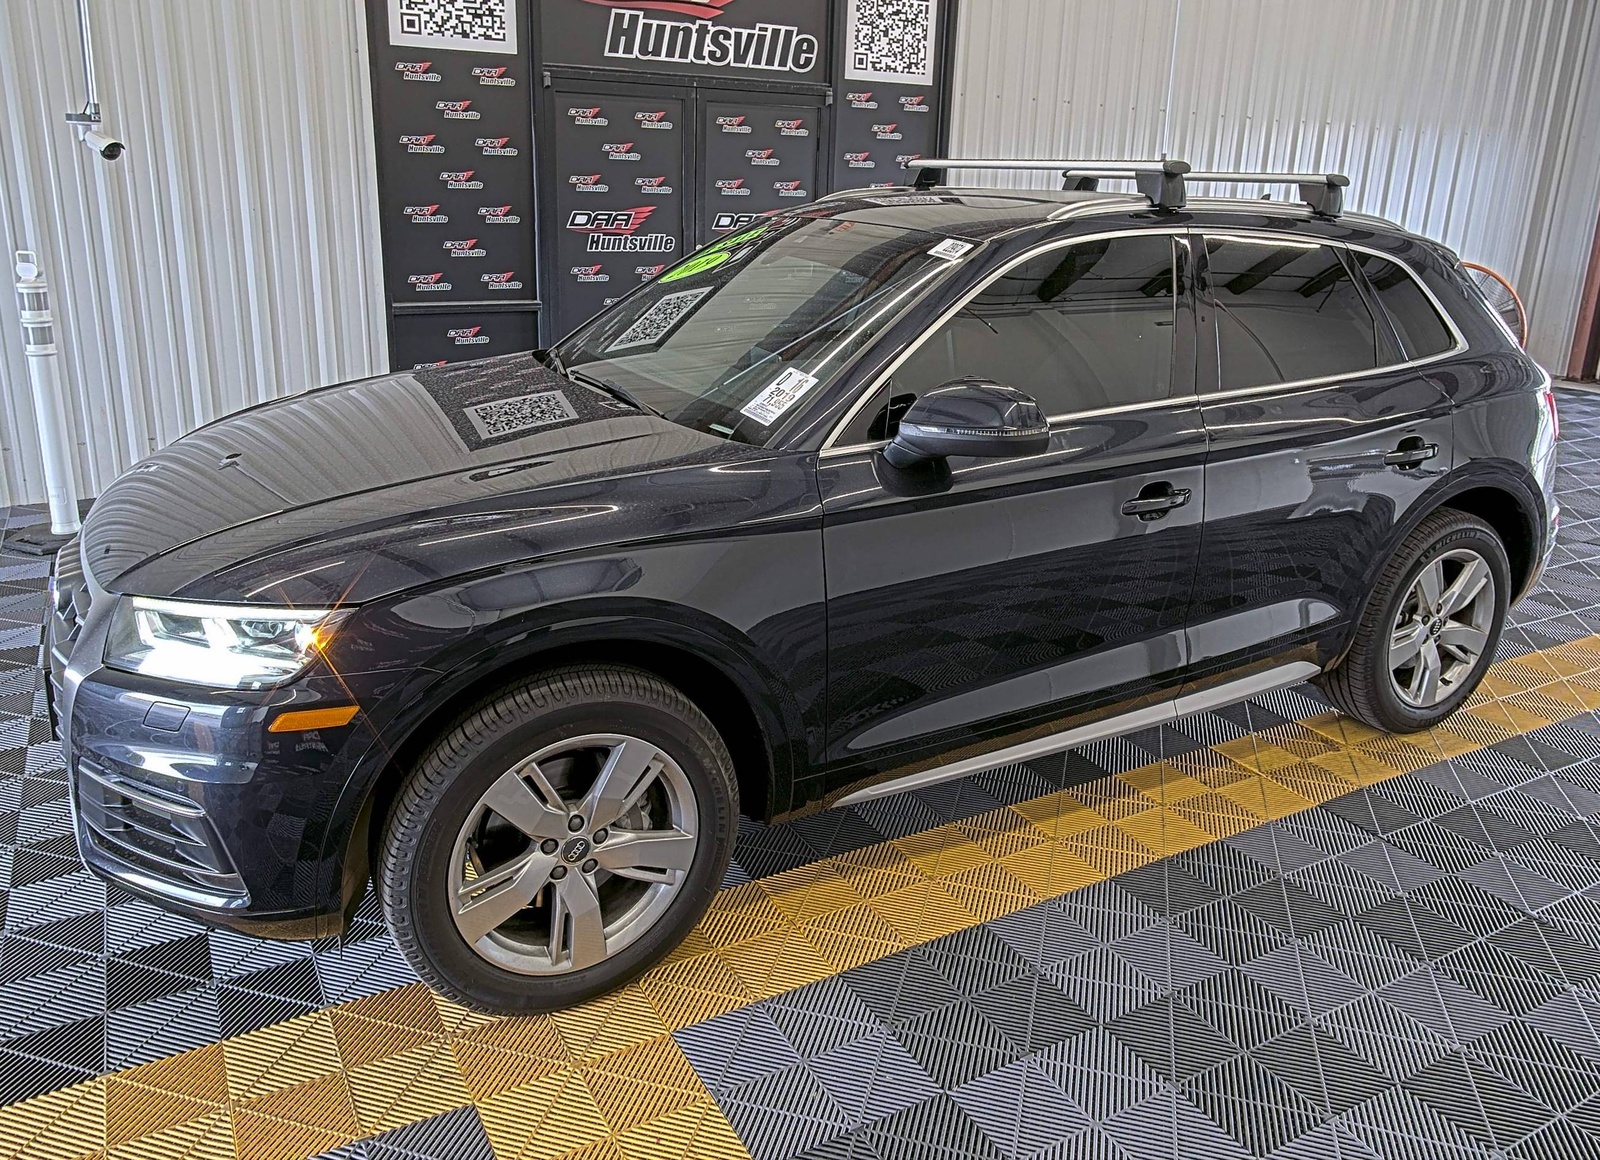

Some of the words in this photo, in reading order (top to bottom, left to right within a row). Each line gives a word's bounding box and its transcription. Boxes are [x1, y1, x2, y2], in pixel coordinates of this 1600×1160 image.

[604, 8, 818, 73] Huntsville
[395, 62, 423, 72] DAA
[403, 72, 442, 82] Huntsville
[472, 68, 498, 77] DAA
[480, 77, 515, 87] Huntsville
[436, 102, 463, 111] DAA
[444, 110, 480, 120] Huntsville
[568, 108, 594, 117] DAA
[634, 112, 658, 121] DAA
[575, 117, 608, 127] Huntsville
[641, 121, 673, 130] Huntsville
[399, 135, 427, 145] DAA
[475, 138, 502, 147] DAA
[408, 144, 445, 154] Huntsville
[483, 147, 518, 156] Huntsville
[602, 143, 627, 152] DAA
[609, 152, 641, 161] Huntsville
[439, 172, 466, 181] DAA
[569, 175, 594, 184] DAA
[447, 181, 484, 190] Huntsville
[635, 177, 659, 186] DAA
[576, 184, 609, 192] Huntsville
[641, 186, 673, 194] Huntsville
[404, 206, 431, 215] DAA
[478, 207, 505, 216] DAA
[412, 215, 449, 224] Huntsville
[486, 215, 520, 224] Huntsville
[566, 211, 636, 229] DAA
[443, 240, 470, 249] DAA
[587, 234, 675, 253] Huntsville
[451, 249, 486, 258] Huntsville
[571, 266, 597, 275] DAA
[408, 275, 435, 284] DAA
[481, 273, 508, 282] DAA
[577, 274, 610, 283] Huntsville
[416, 283, 452, 292] Huntsville
[489, 282, 523, 290] Huntsville
[447, 328, 474, 337] DAA
[455, 335, 490, 345] Huntsville
[770, 387, 796, 402] 2019
[1435, 531, 1476, 550] MICHELIN
